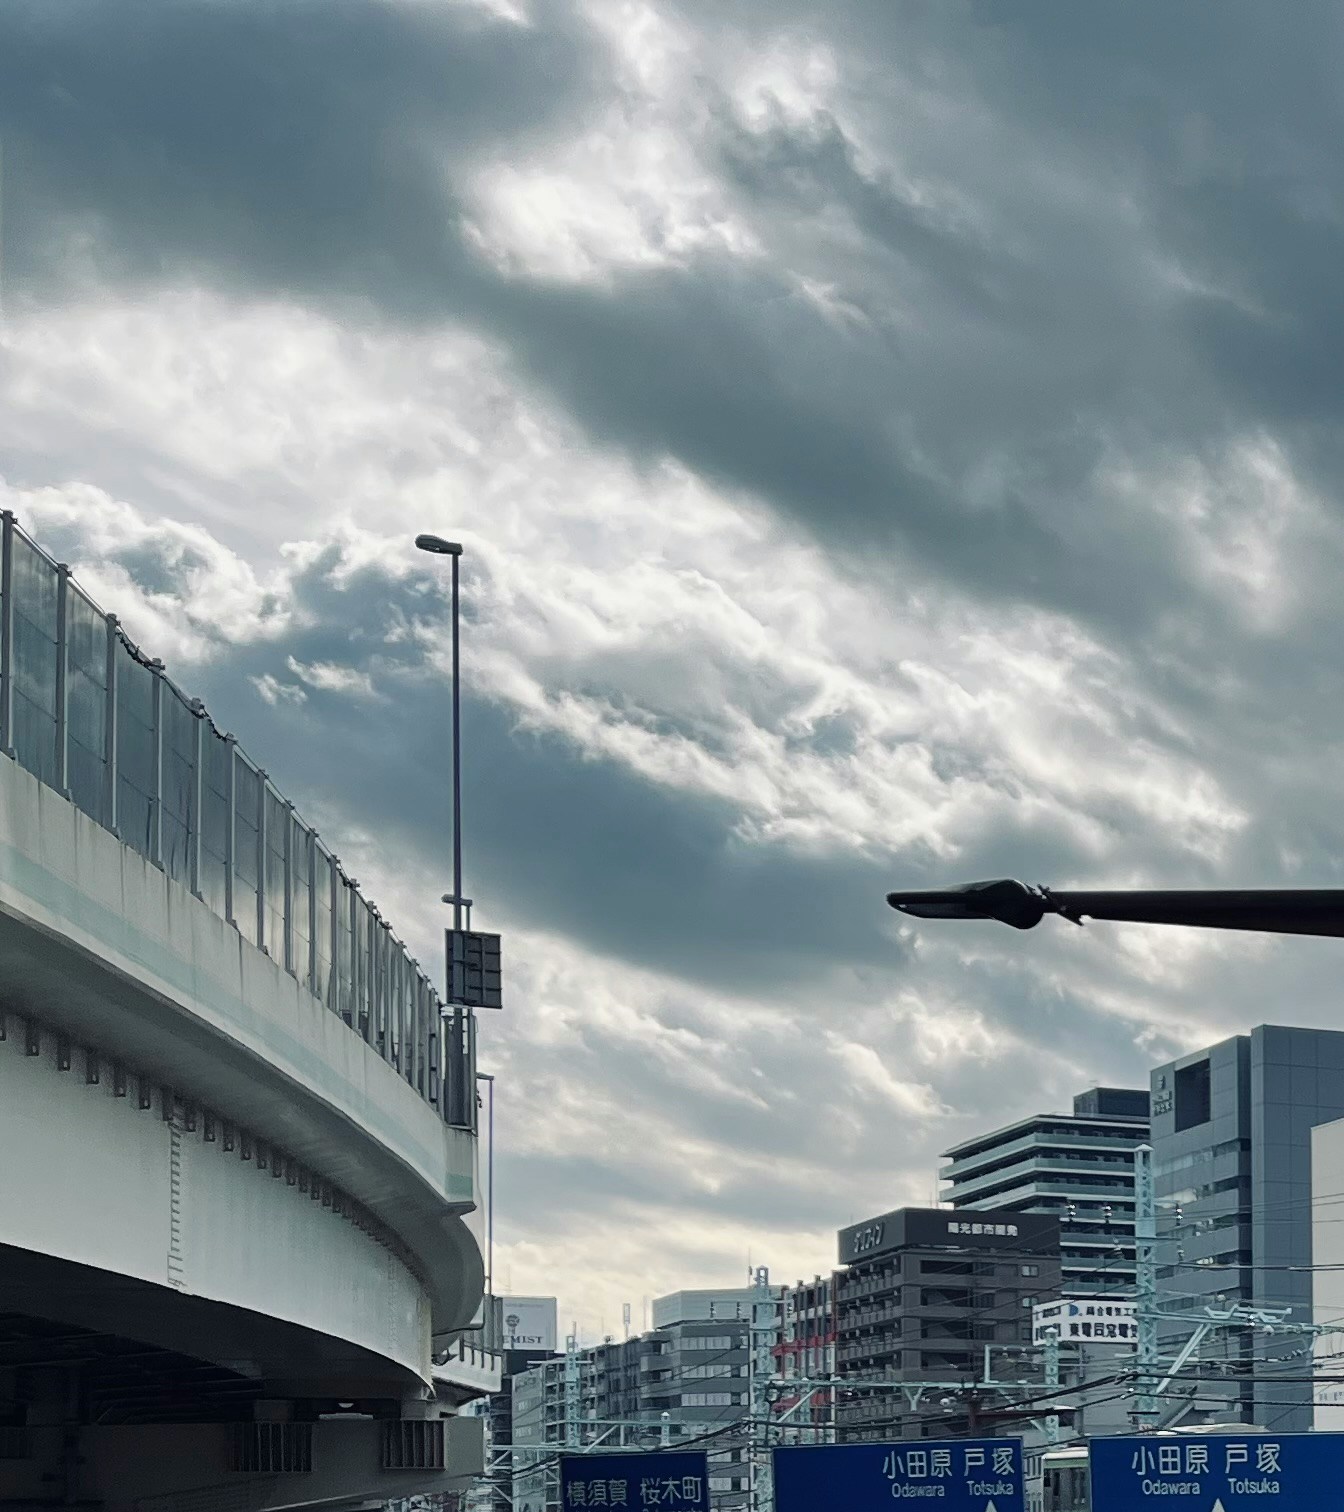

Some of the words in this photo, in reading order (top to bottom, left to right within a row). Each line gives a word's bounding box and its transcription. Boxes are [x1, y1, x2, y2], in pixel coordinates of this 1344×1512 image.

[883, 1449, 953, 1480] 小田原
[964, 1447, 1015, 1476] 戸塚
[1132, 1444, 1209, 1475] 小田原
[1224, 1443, 1281, 1474] 戸塚
[566, 1478, 628, 1507] 横須賀
[640, 1476, 702, 1505] 桜木町
[891, 1482, 946, 1498] Odawara
[966, 1480, 1014, 1496] Totsuka
[1142, 1479, 1200, 1495] Odawara
[1228, 1478, 1280, 1494] Totsuka
